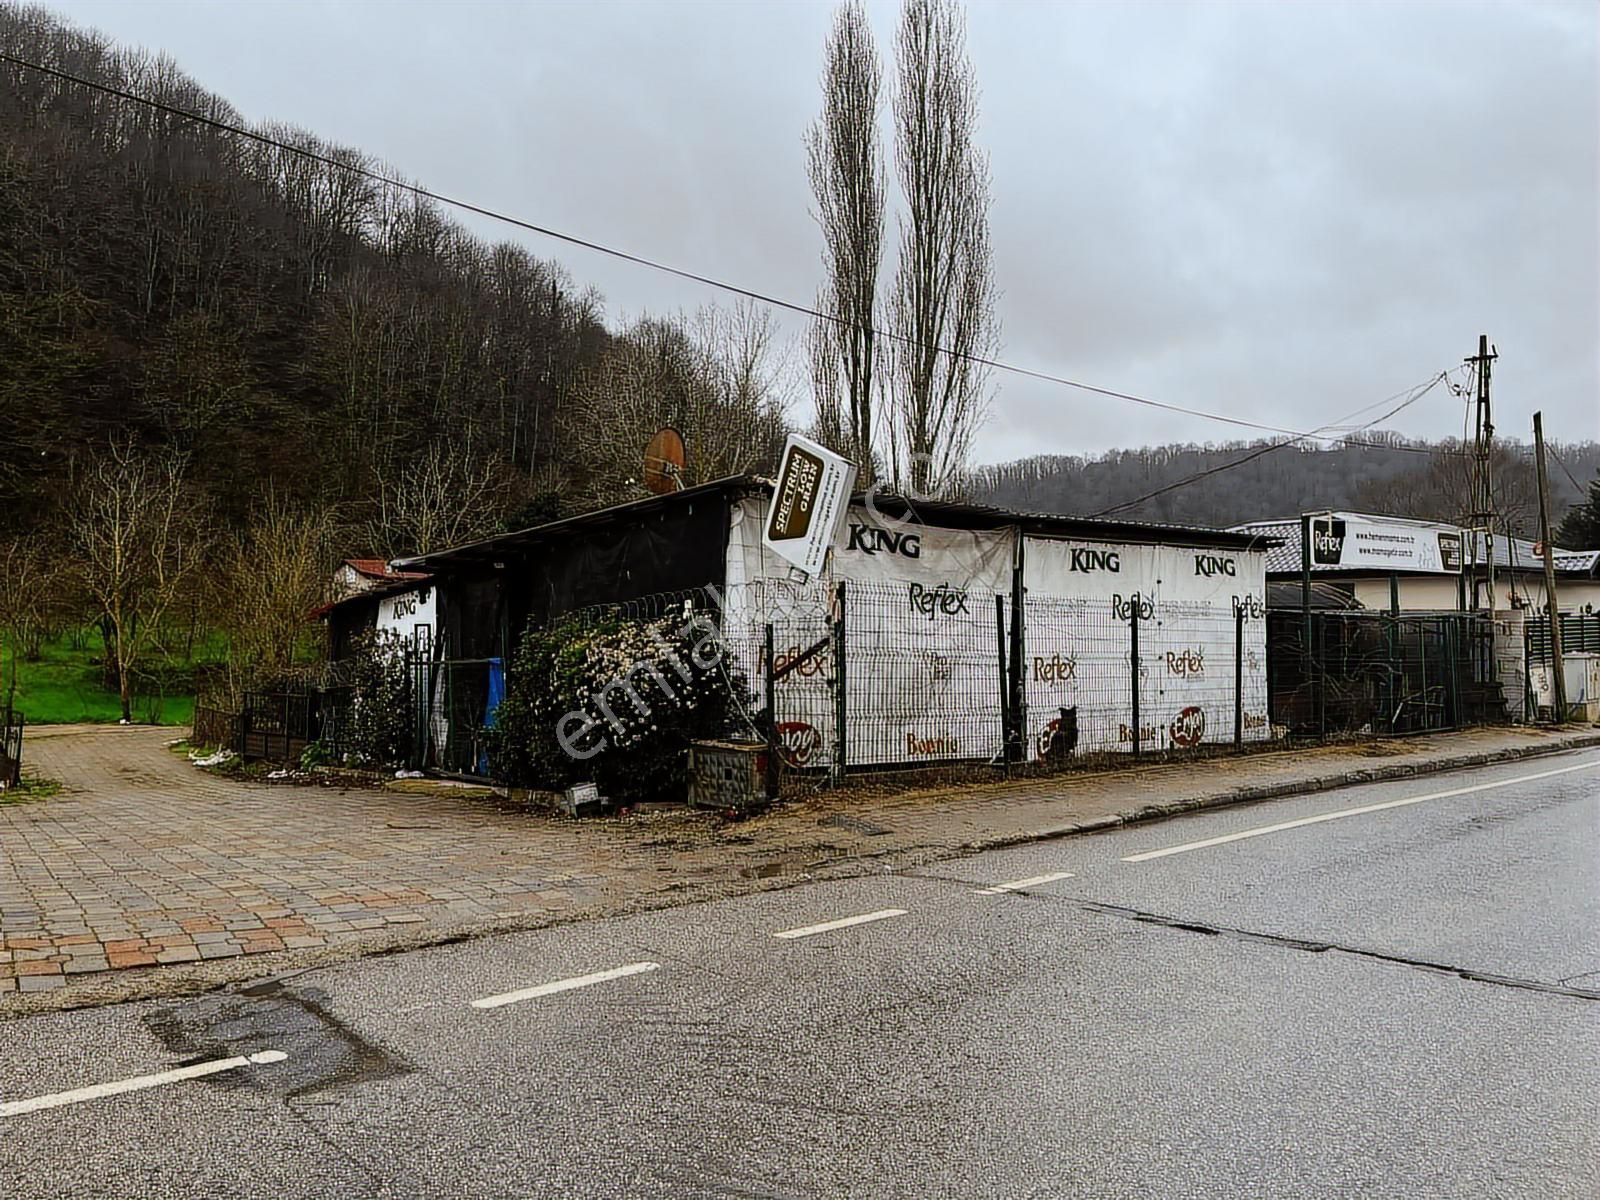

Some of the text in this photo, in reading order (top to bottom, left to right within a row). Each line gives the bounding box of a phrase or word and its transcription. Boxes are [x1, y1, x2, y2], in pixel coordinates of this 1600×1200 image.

[798, 459, 810, 493] LOW
[801, 463, 818, 512] GRAIN
[776, 453, 802, 533] SPECTRUM
[848, 523, 920, 559] KING
[1315, 530, 1341, 555] Reflex
[1070, 548, 1120, 574] KING
[1195, 555, 1236, 577] KING
[393, 599, 416, 620] KING
[909, 582, 970, 622] Reflex
[1033, 653, 1076, 682] Reflex
[1166, 648, 1204, 679] Reflex
[1119, 723, 1157, 742] Bonie
